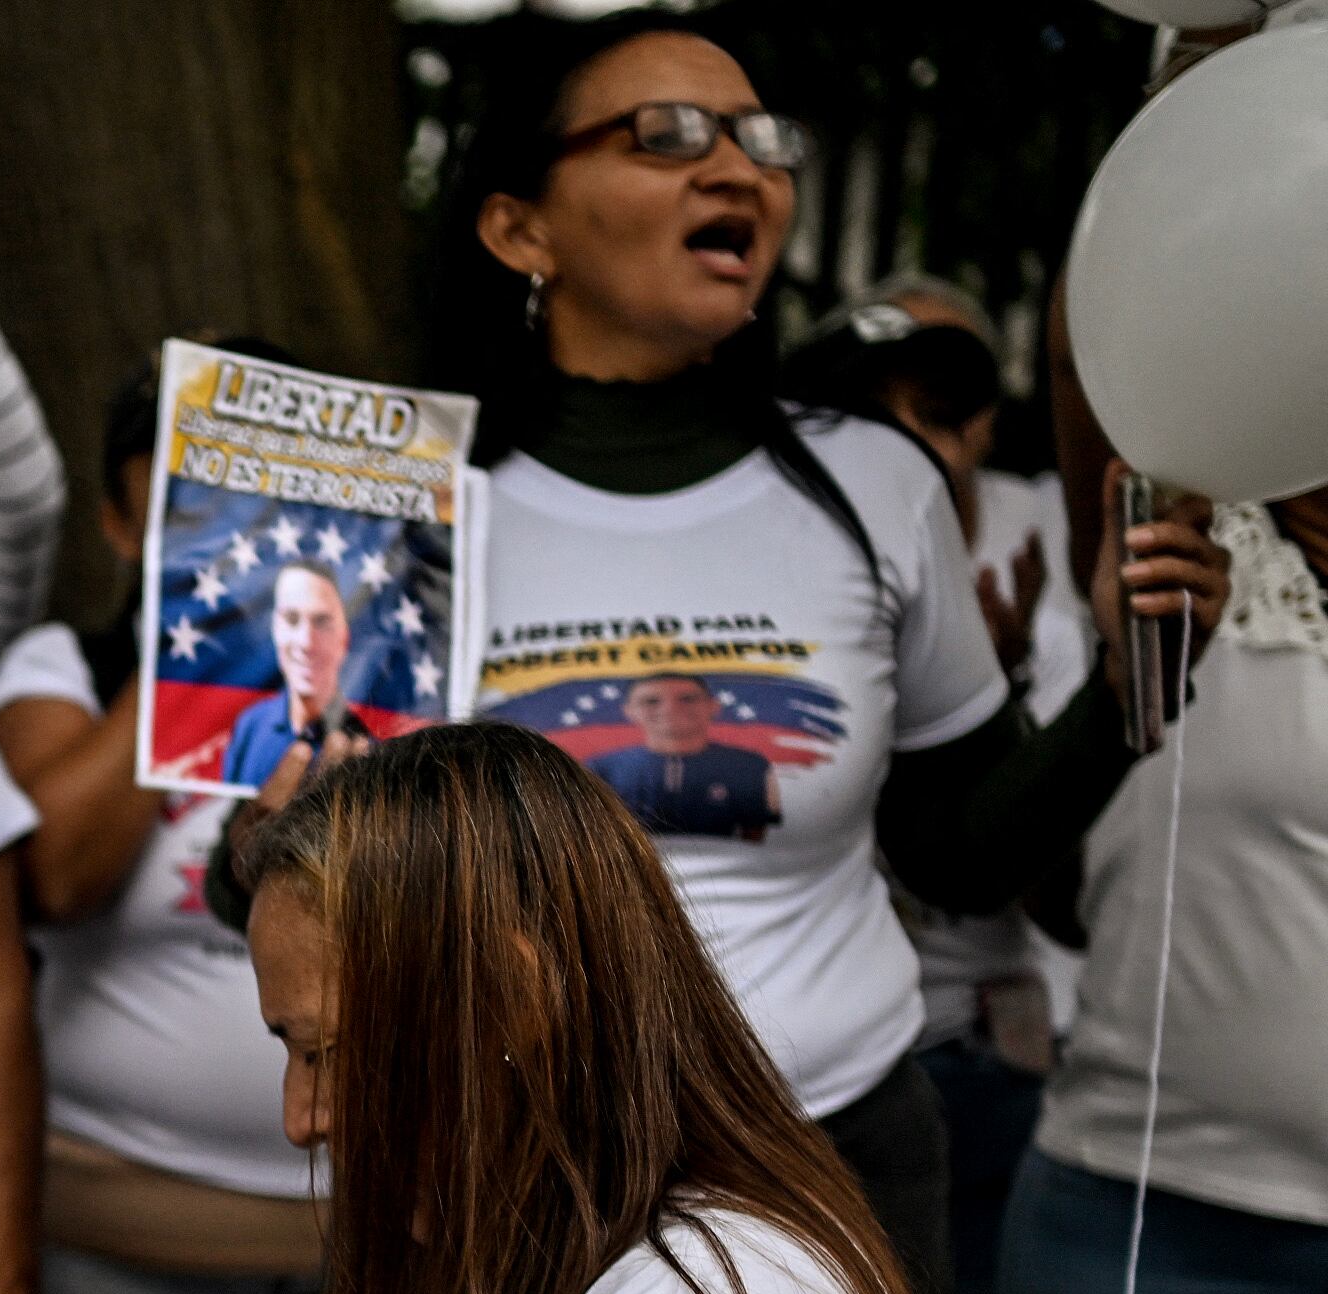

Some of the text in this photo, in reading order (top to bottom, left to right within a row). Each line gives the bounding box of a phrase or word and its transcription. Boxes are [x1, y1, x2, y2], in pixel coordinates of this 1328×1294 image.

[211, 360, 418, 450] LIBERTAD
[181, 441, 440, 523] NO ES TERRORISTA
[490, 613, 778, 648] LIBERTAD PARA
[637, 639, 811, 663] CAMPOS
